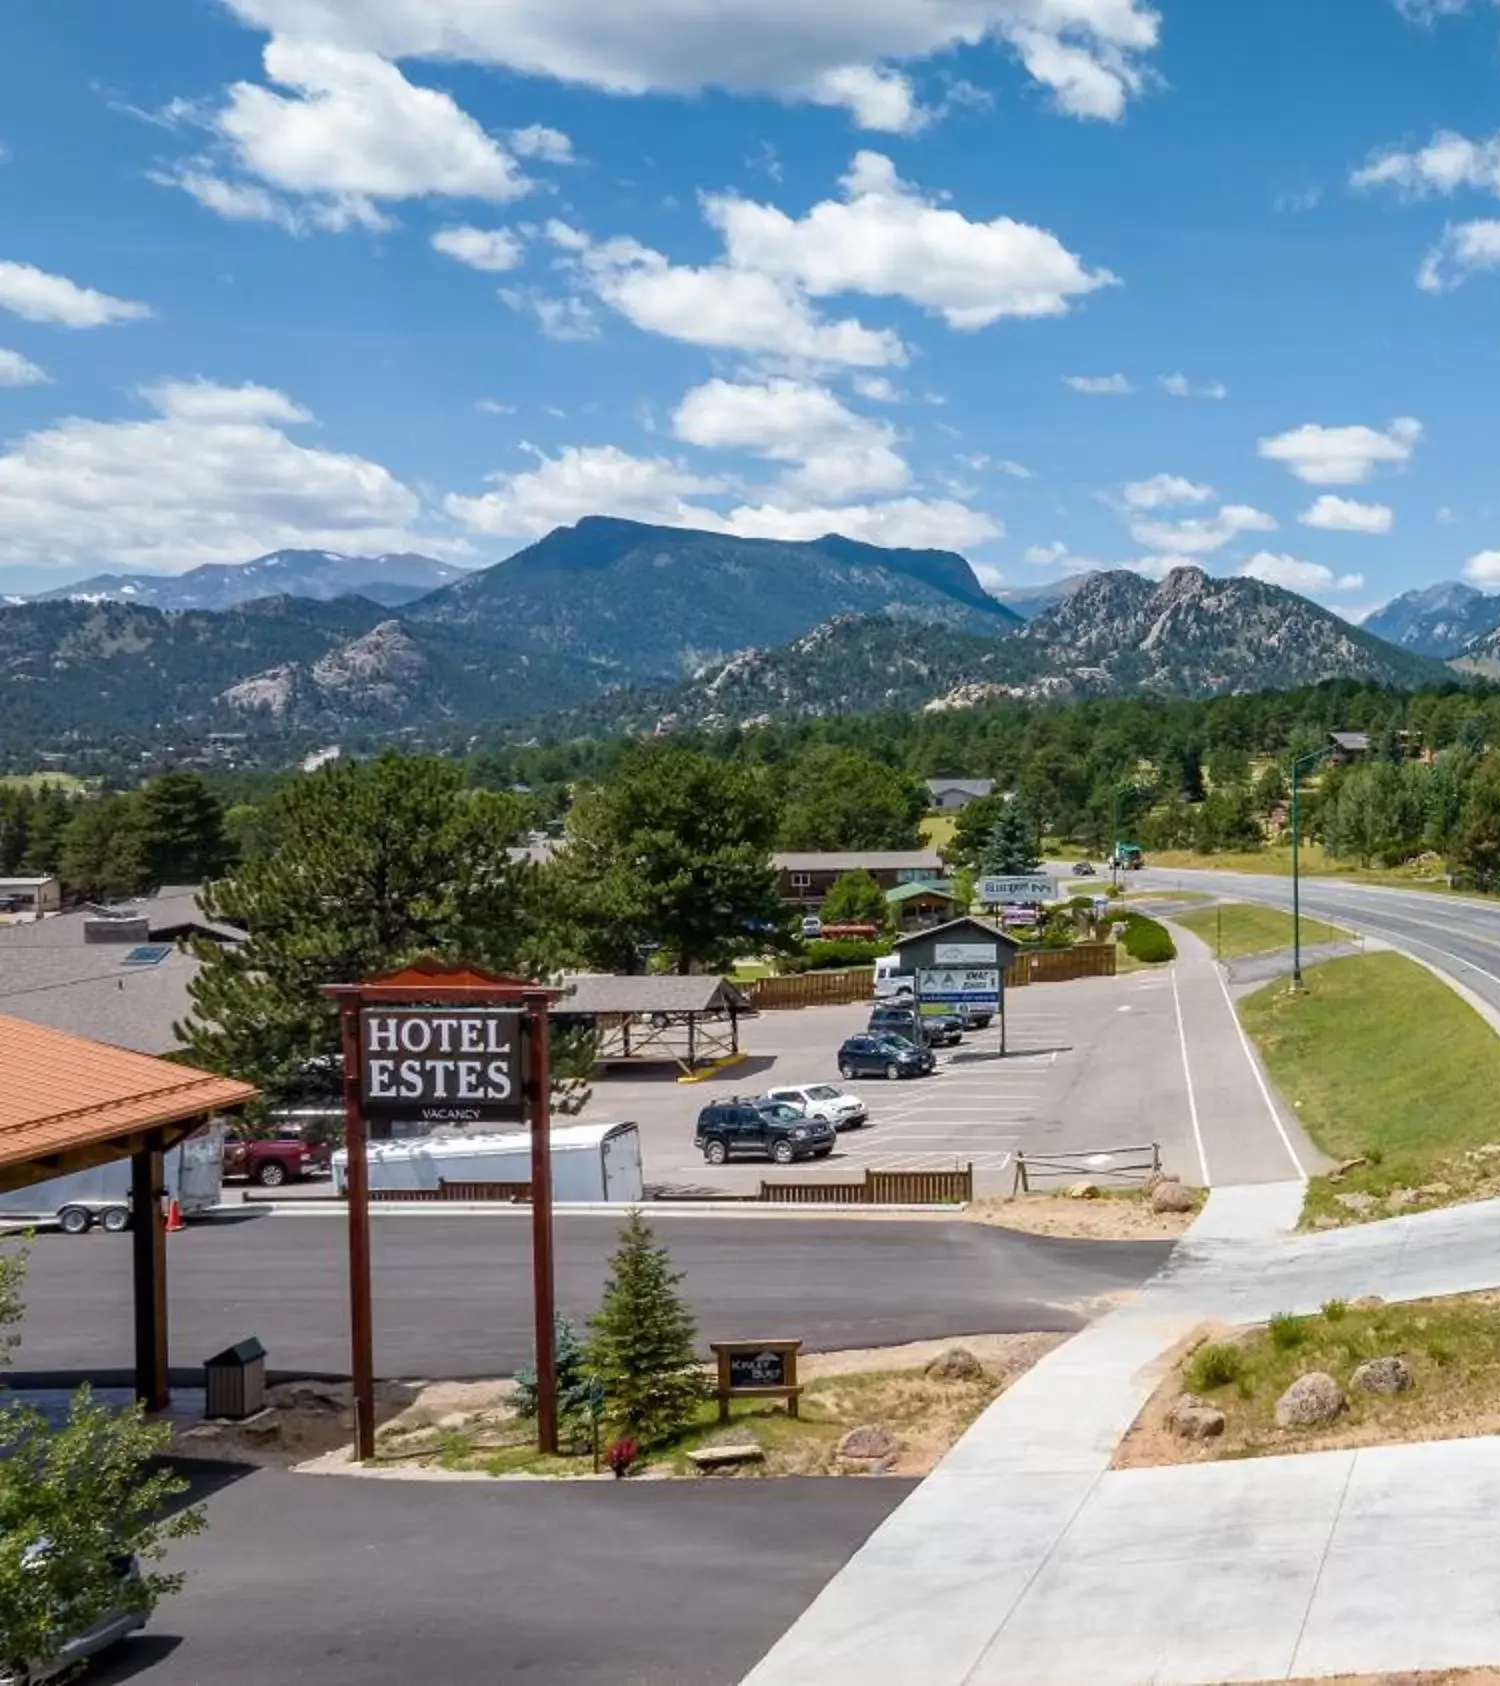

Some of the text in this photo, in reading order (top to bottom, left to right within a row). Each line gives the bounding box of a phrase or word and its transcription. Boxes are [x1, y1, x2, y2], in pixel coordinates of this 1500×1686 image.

[368, 1018, 511, 1053] HOTEL
[369, 1059, 511, 1099] ESTES
[422, 1109, 481, 1120] VACANCY
